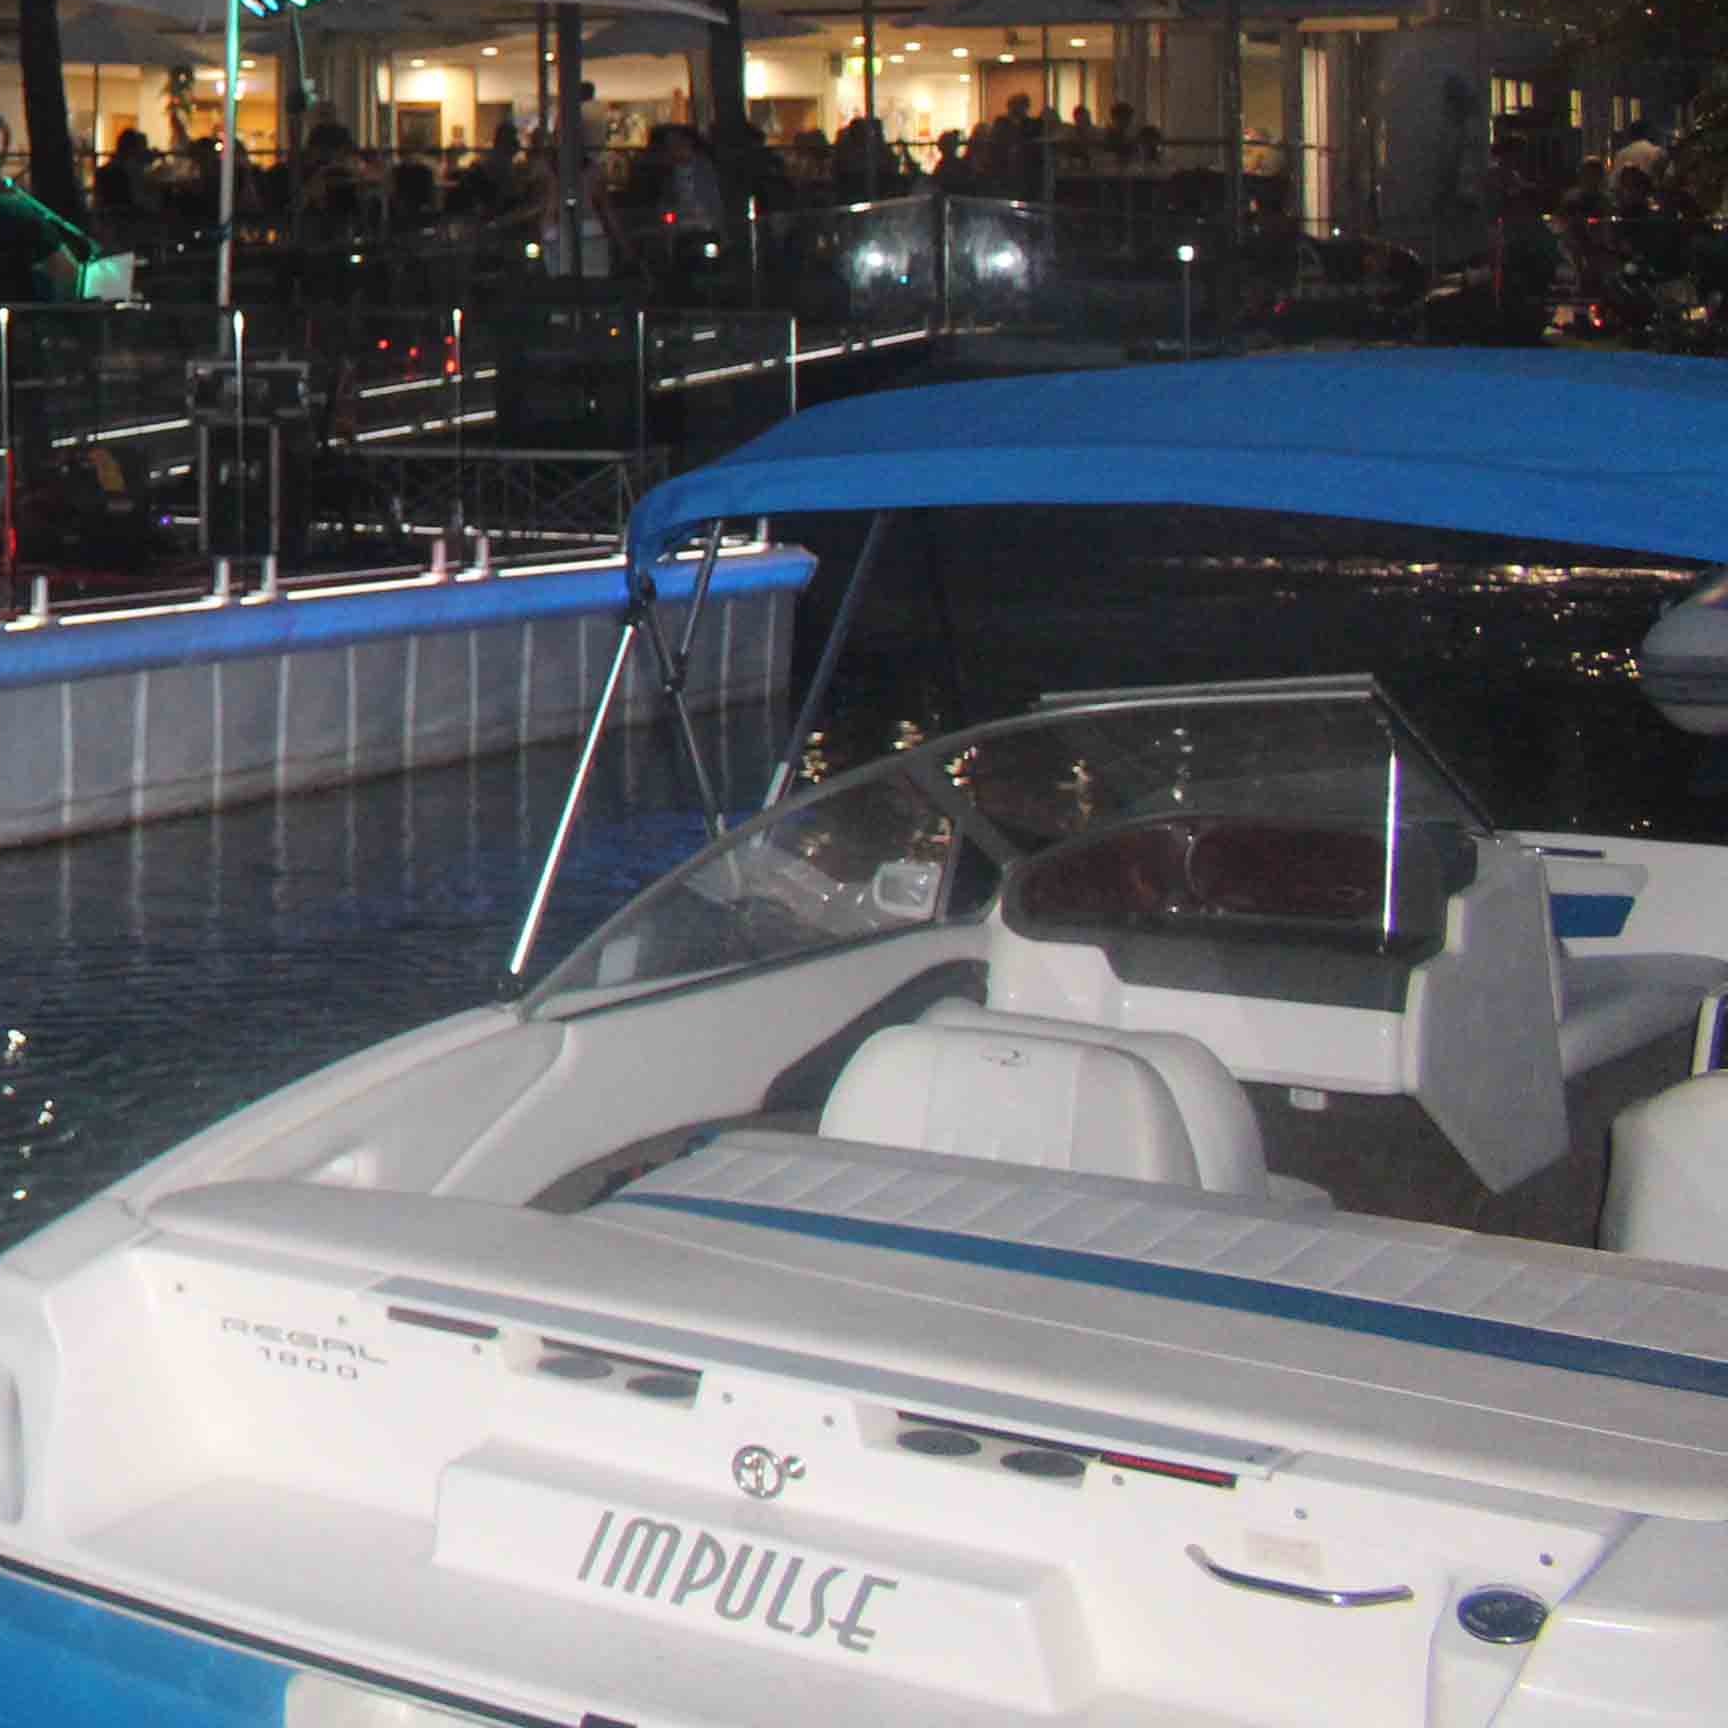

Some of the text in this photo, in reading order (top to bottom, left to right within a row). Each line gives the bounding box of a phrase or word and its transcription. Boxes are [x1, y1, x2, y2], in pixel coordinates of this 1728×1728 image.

[221, 1316, 389, 1365] REGAL
[257, 1345, 359, 1382] 1800
[576, 1509, 900, 1654] IMPULSE
